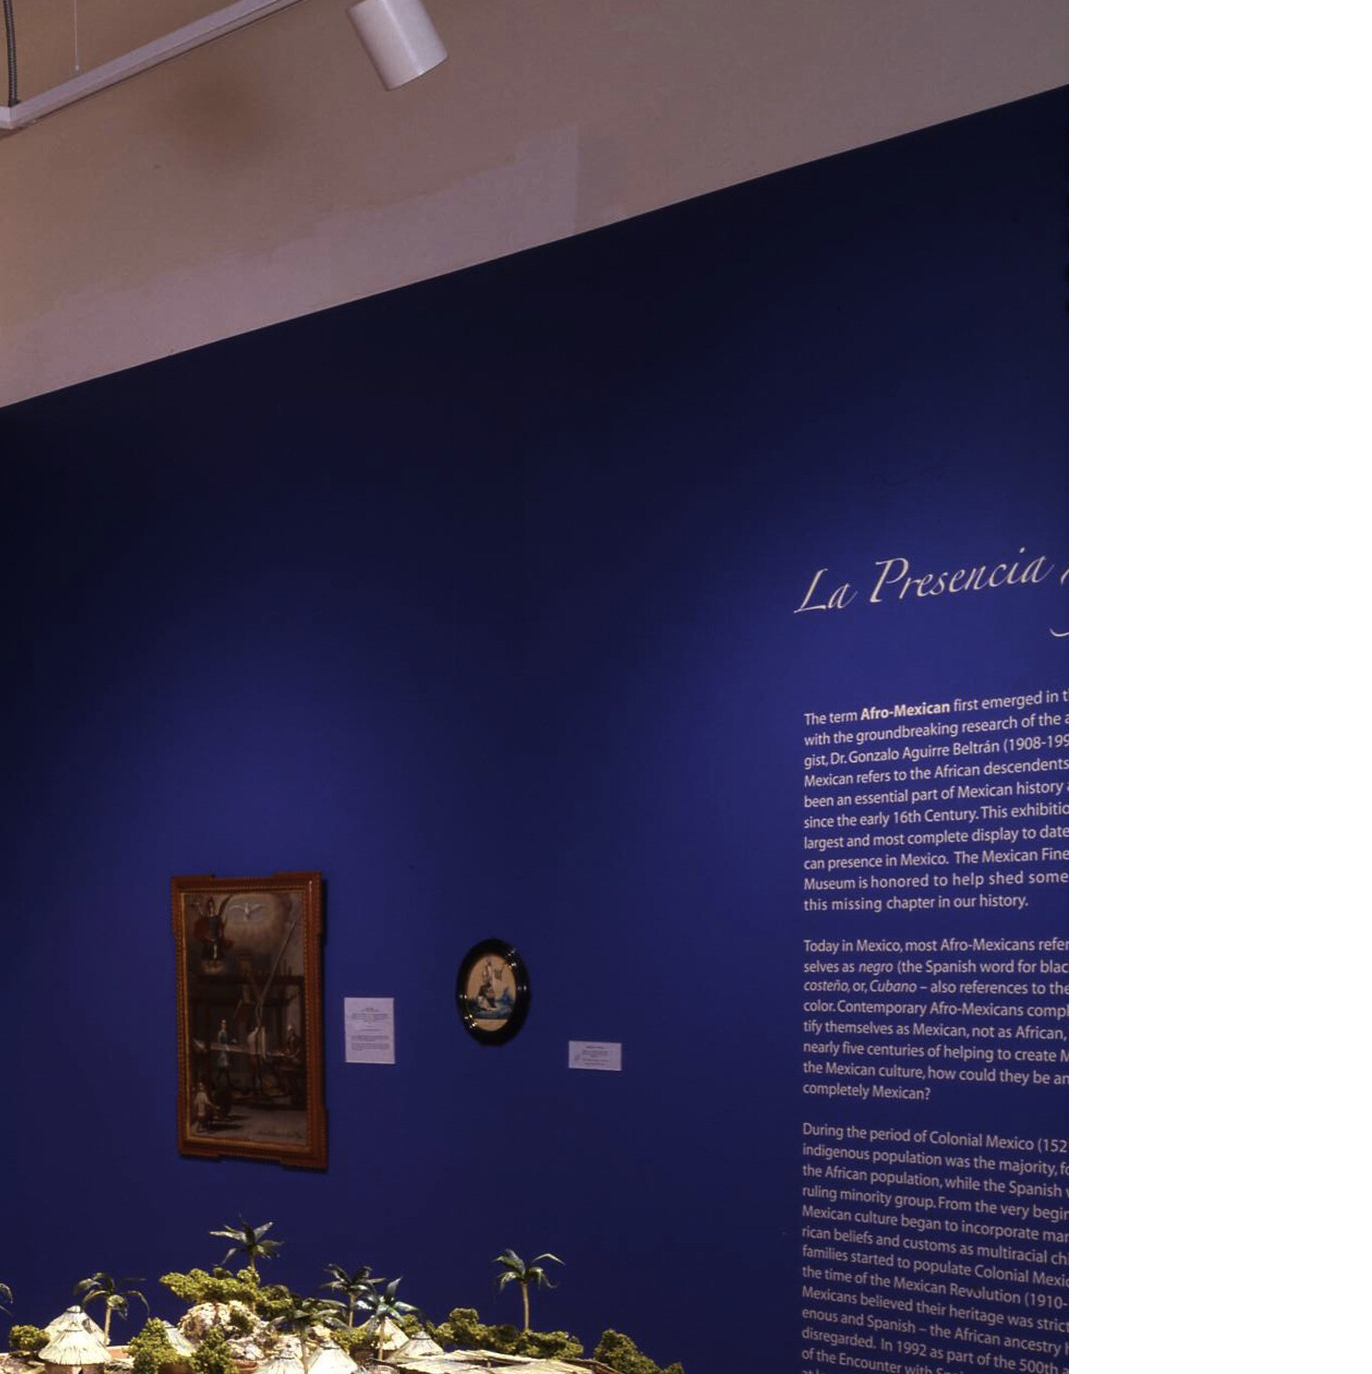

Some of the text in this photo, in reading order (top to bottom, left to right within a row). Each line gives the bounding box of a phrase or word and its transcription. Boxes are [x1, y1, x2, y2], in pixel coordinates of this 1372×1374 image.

[793, 568, 858, 614] La
[870, 547, 1052, 603] Presencia
[804, 690, 1059, 725] The term Afro-Mexican first emerged in
[804, 712, 1062, 746] with the groundbreaking research of the
[804, 754, 829, 770] gist,
[830, 752, 848, 765] Dr.
[848, 747, 900, 763] Gonzalo
[902, 745, 950, 762] Aguirre
[953, 740, 1000, 755] Beltrán
[804, 758, 1069, 787] Mexican refers to the African descendents
[804, 781, 1064, 808] been an essential part of Mexican history
[804, 816, 835, 829] since
[836, 814, 858, 827] the
[859, 811, 890, 827] early
[893, 810, 922, 823] 16th
[924, 809, 980, 823] Century.
[980, 805, 1008, 819] This
[804, 825, 1069, 852] largest and most complete display to date
[803, 847, 1069, 872] can presence in Mexico. The Mexican Fine
[804, 870, 1068, 890] Museum is honored to help shed some
[803, 894, 1028, 913] this missing chapter in our history.
[803, 939, 840, 955] Today
[842, 939, 854, 951] in
[856, 939, 904, 952] Mexico,
[905, 940, 938, 951] most
[940, 938, 1036, 951] Afro-Mexicans
[804, 959, 1068, 976] selves as negro (the Spanish word for blac
[803, 979, 851, 992] costeño,
[852, 982, 868, 994] or,
[869, 979, 918, 993] Cubano
[930, 980, 957, 993] also
[959, 980, 1029, 994] references
[1031, 983, 1046, 994] to
[1049, 981, 1069, 995] the
[803, 999, 836, 1012] color.
[837, 1000, 928, 1017] Contemporary
[929, 1001, 1024, 1017] Afro-Mexicans
[803, 1019, 1066, 1041] tify themselves as Mexican, not as African,
[803, 1040, 1057, 1063] nearly five centuries of helping to create
[803, 1060, 824, 1074] the
[825, 1062, 876, 1076] Mexican
[878, 1064, 926, 1080] culture,
[927, 1065, 957, 1079] how
[959, 1068, 996, 1082] could
[999, 1069, 1030, 1086] they
[1033, 1070, 1051, 1084] be
[803, 1083, 931, 1100] completely Mexican?
[803, 1122, 844, 1140] During
[846, 1125, 868, 1139] the
[869, 1128, 911, 1142] period
[913, 1129, 928, 1143] of
[929, 1131, 983, 1147] Colonial
[985, 1135, 1035, 1150] Mexico
[803, 1143, 870, 1160] indigenous
[872, 1150, 942, 1165] population
[945, 1157, 971, 1168] was
[973, 1155, 996, 1170] the
[802, 1164, 823, 1177] the
[825, 1165, 868, 1181] African
[944, 1176, 981, 1191] while
[983, 1178, 1006, 1193] the
[1009, 1180, 1062, 1197] Spanish
